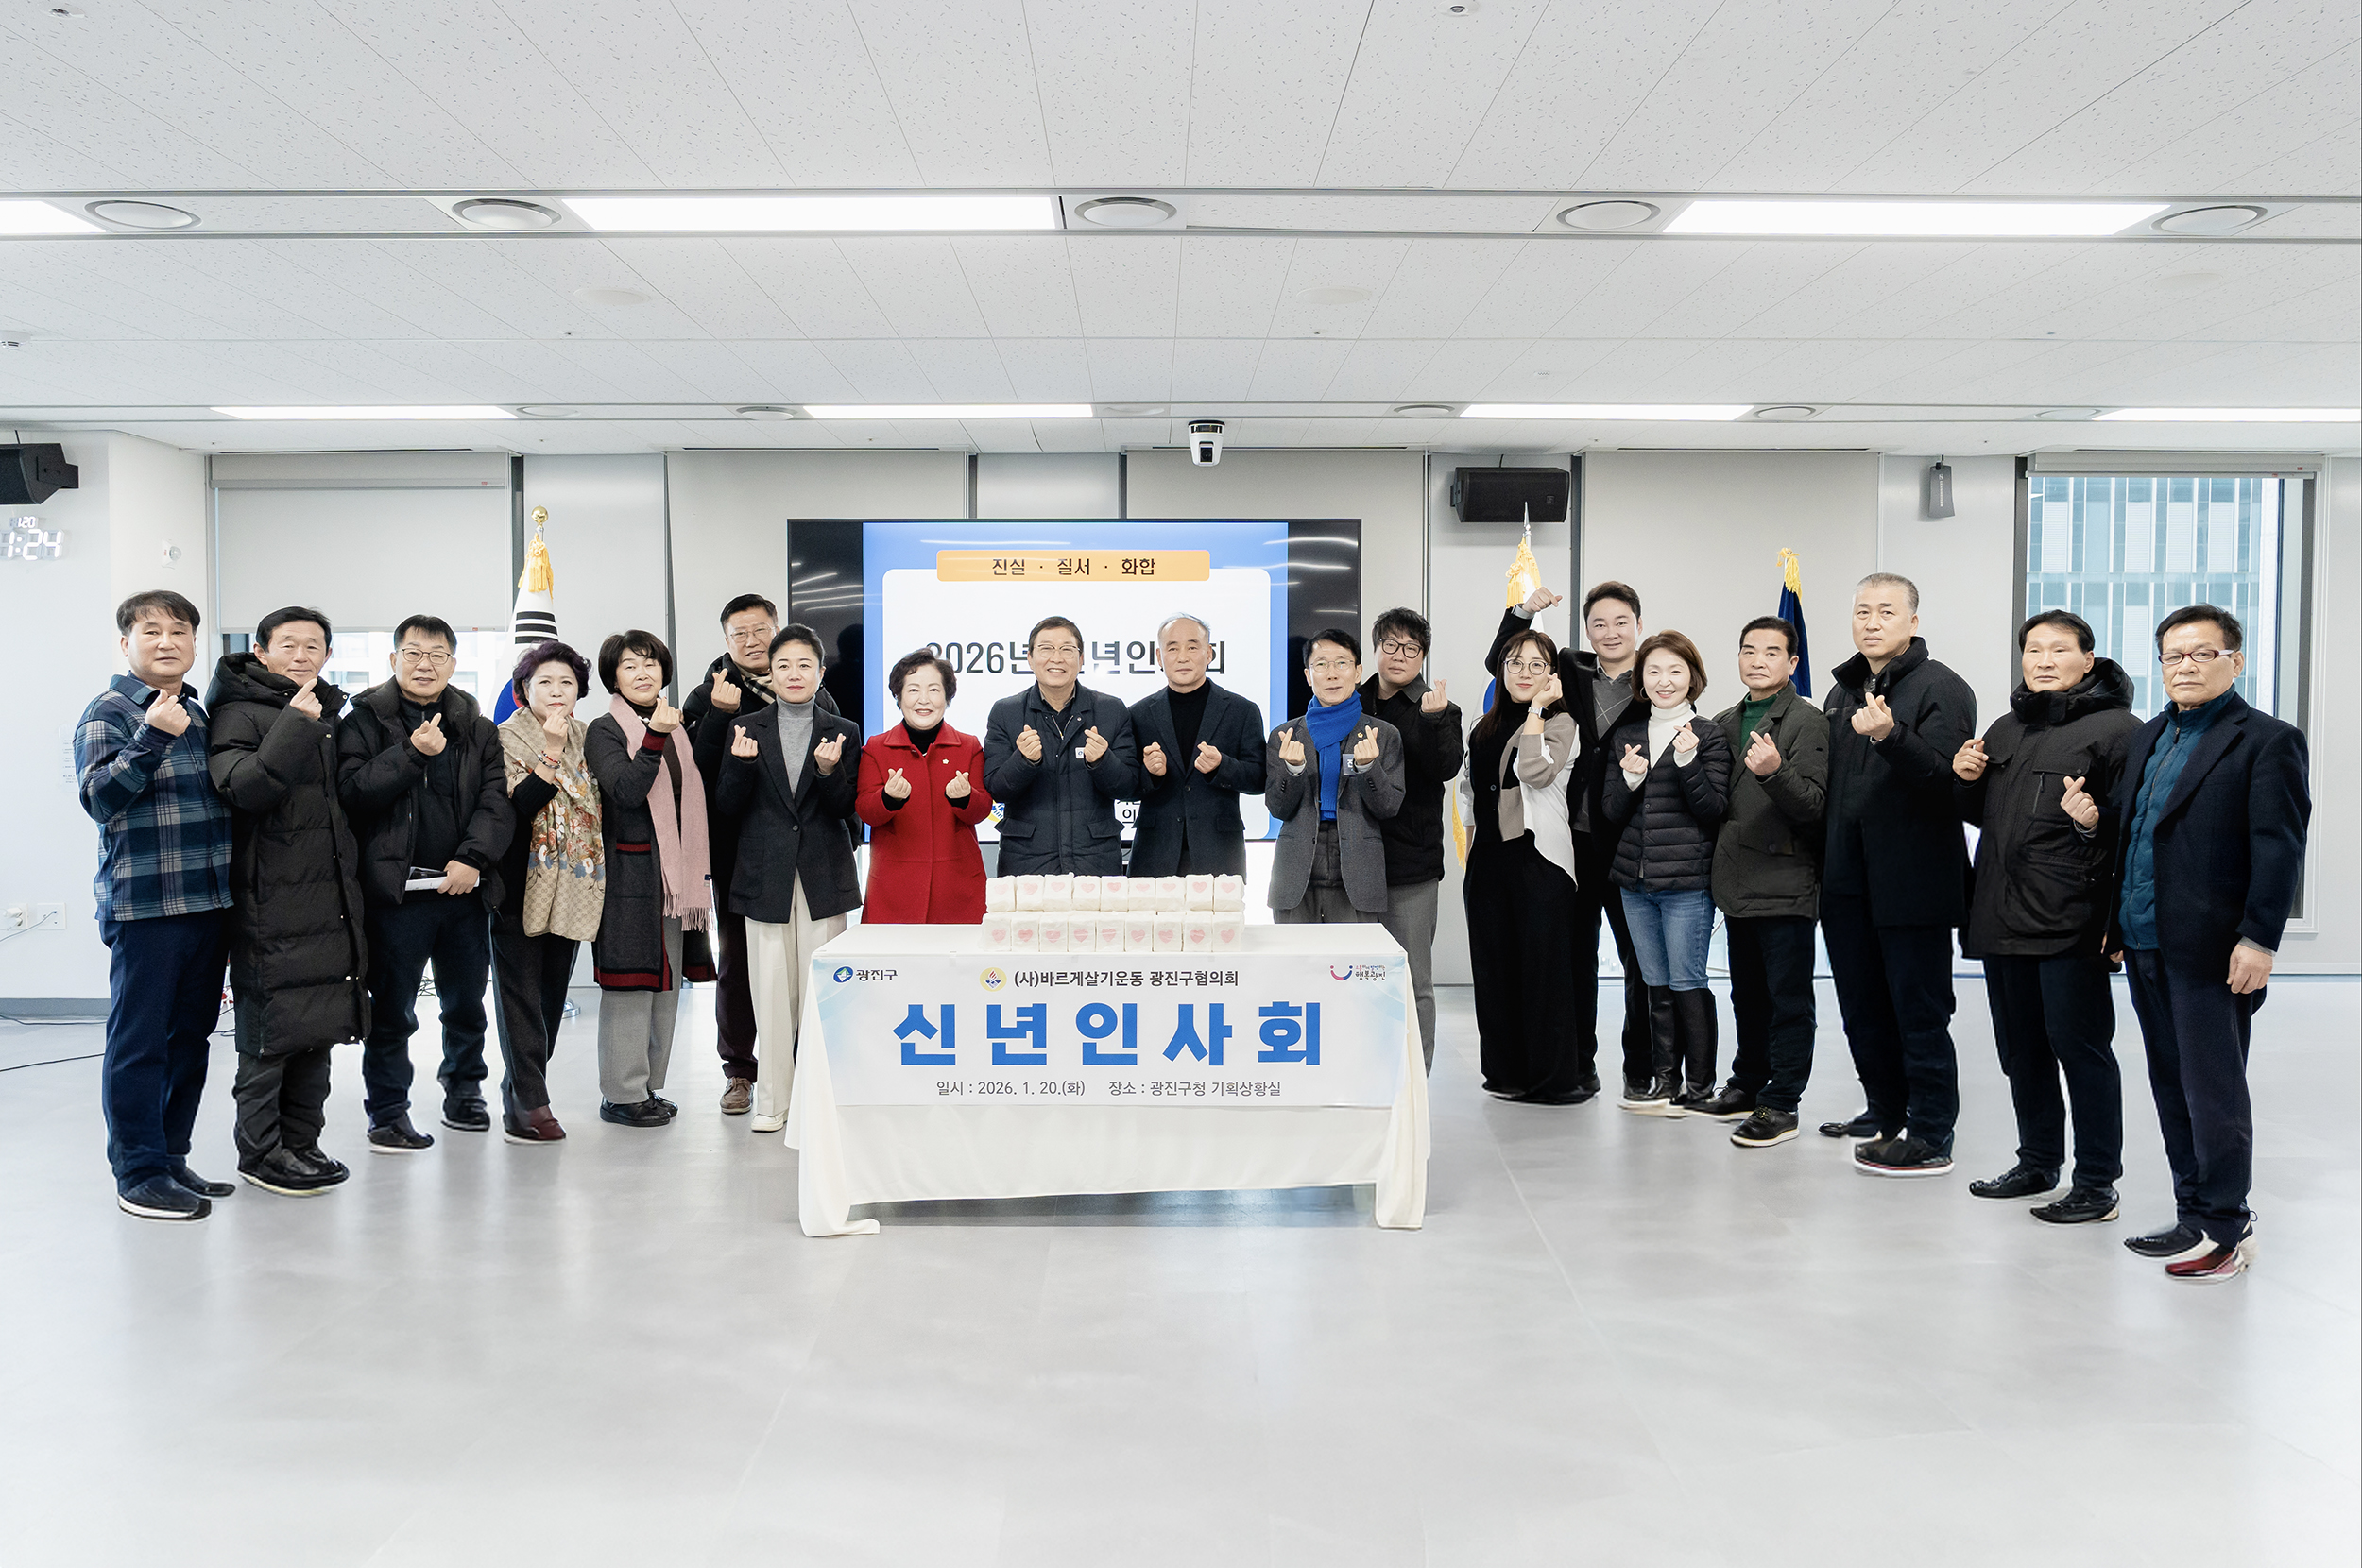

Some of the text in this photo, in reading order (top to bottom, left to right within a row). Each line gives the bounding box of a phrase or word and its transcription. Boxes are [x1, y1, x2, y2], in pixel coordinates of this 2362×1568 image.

[992, 558, 1025, 575] 진실
[1056, 558, 1090, 575] 질서
[1121, 558, 1156, 575] 화합
[855, 969, 899, 982] 광진구
[1014, 970, 1240, 987] (사)바르게살기운동 광진구협의회
[936, 1081, 964, 1096] 일시
[978, 1081, 1018, 1096] 2026.
[1022, 1081, 1035, 1096] 1.
[1039, 1080, 1086, 1097] 20.(화)
[1108, 1081, 1137, 1097] 장소
[1150, 1081, 1206, 1097] 광진구청
[1211, 1081, 1281, 1097] 기획상황실
